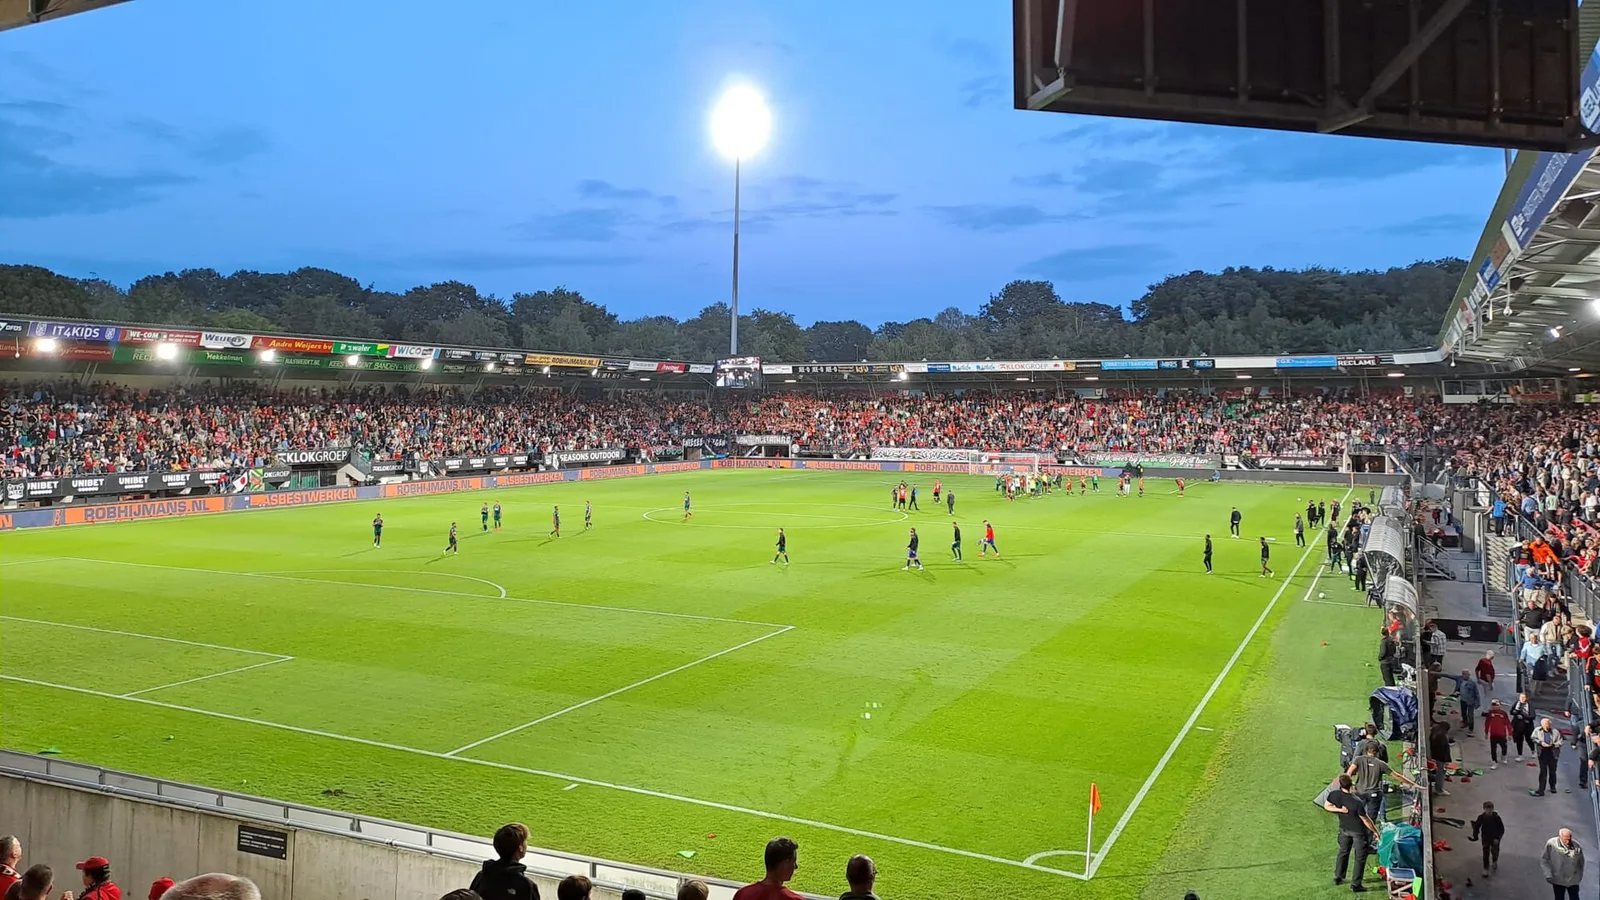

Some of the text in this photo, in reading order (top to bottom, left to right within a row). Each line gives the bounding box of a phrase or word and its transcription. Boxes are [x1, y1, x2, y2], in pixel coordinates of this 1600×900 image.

[52, 325, 100, 339] IT4KIDS
[129, 330, 159, 339] WE-COM
[269, 340, 293, 348] Andre
[286, 450, 348, 463] KLOKGROEP
[559, 450, 620, 462] SEASONS OUTDOOR
[71, 478, 105, 488] UNIBET
[118, 476, 149, 485] UNIBET
[162, 473, 191, 483] UNIBET
[396, 479, 472, 495] ROBHIJMANS.NL
[84, 499, 210, 520] ROBHIJMANS.NL
